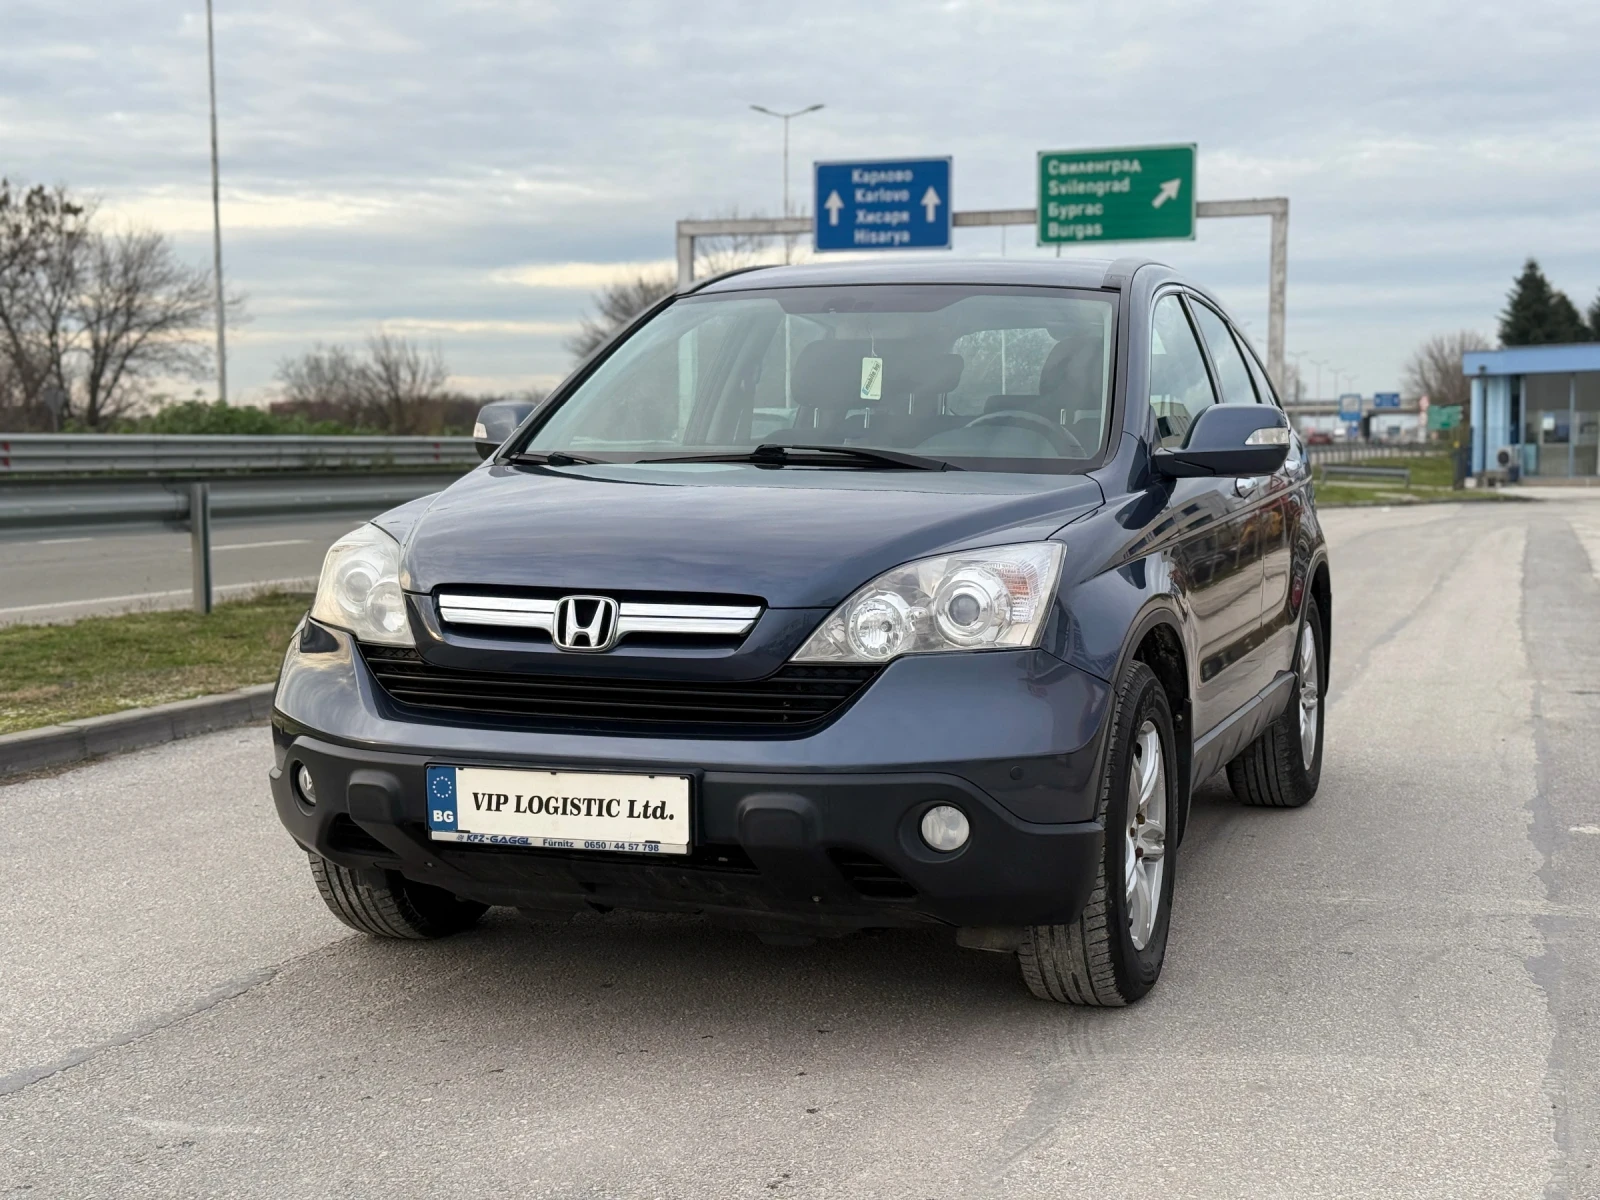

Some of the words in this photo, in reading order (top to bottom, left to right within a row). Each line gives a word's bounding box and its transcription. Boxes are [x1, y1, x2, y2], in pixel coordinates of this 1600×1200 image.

[1047, 158, 1142, 176] Свиленград
[851, 168, 914, 187] Карлово
[854, 186, 911, 203] Karlovo
[1047, 176, 1131, 198] Svilengrad
[855, 209, 911, 227] Хисаря
[1047, 201, 1104, 220] Бургас
[853, 228, 911, 246] Hisarya
[1047, 221, 1103, 240] Burgas
[472, 792, 509, 812] VIP
[514, 795, 621, 818] LOGISTIC
[626, 799, 675, 820] Ltd.
[433, 810, 454, 822] BG
[466, 834, 532, 846] KFZ-GAGGL
[542, 838, 574, 848] Fürnitz
[584, 841, 607, 850] 0650
[614, 843, 626, 851] 44
[642, 844, 660, 852] 798
